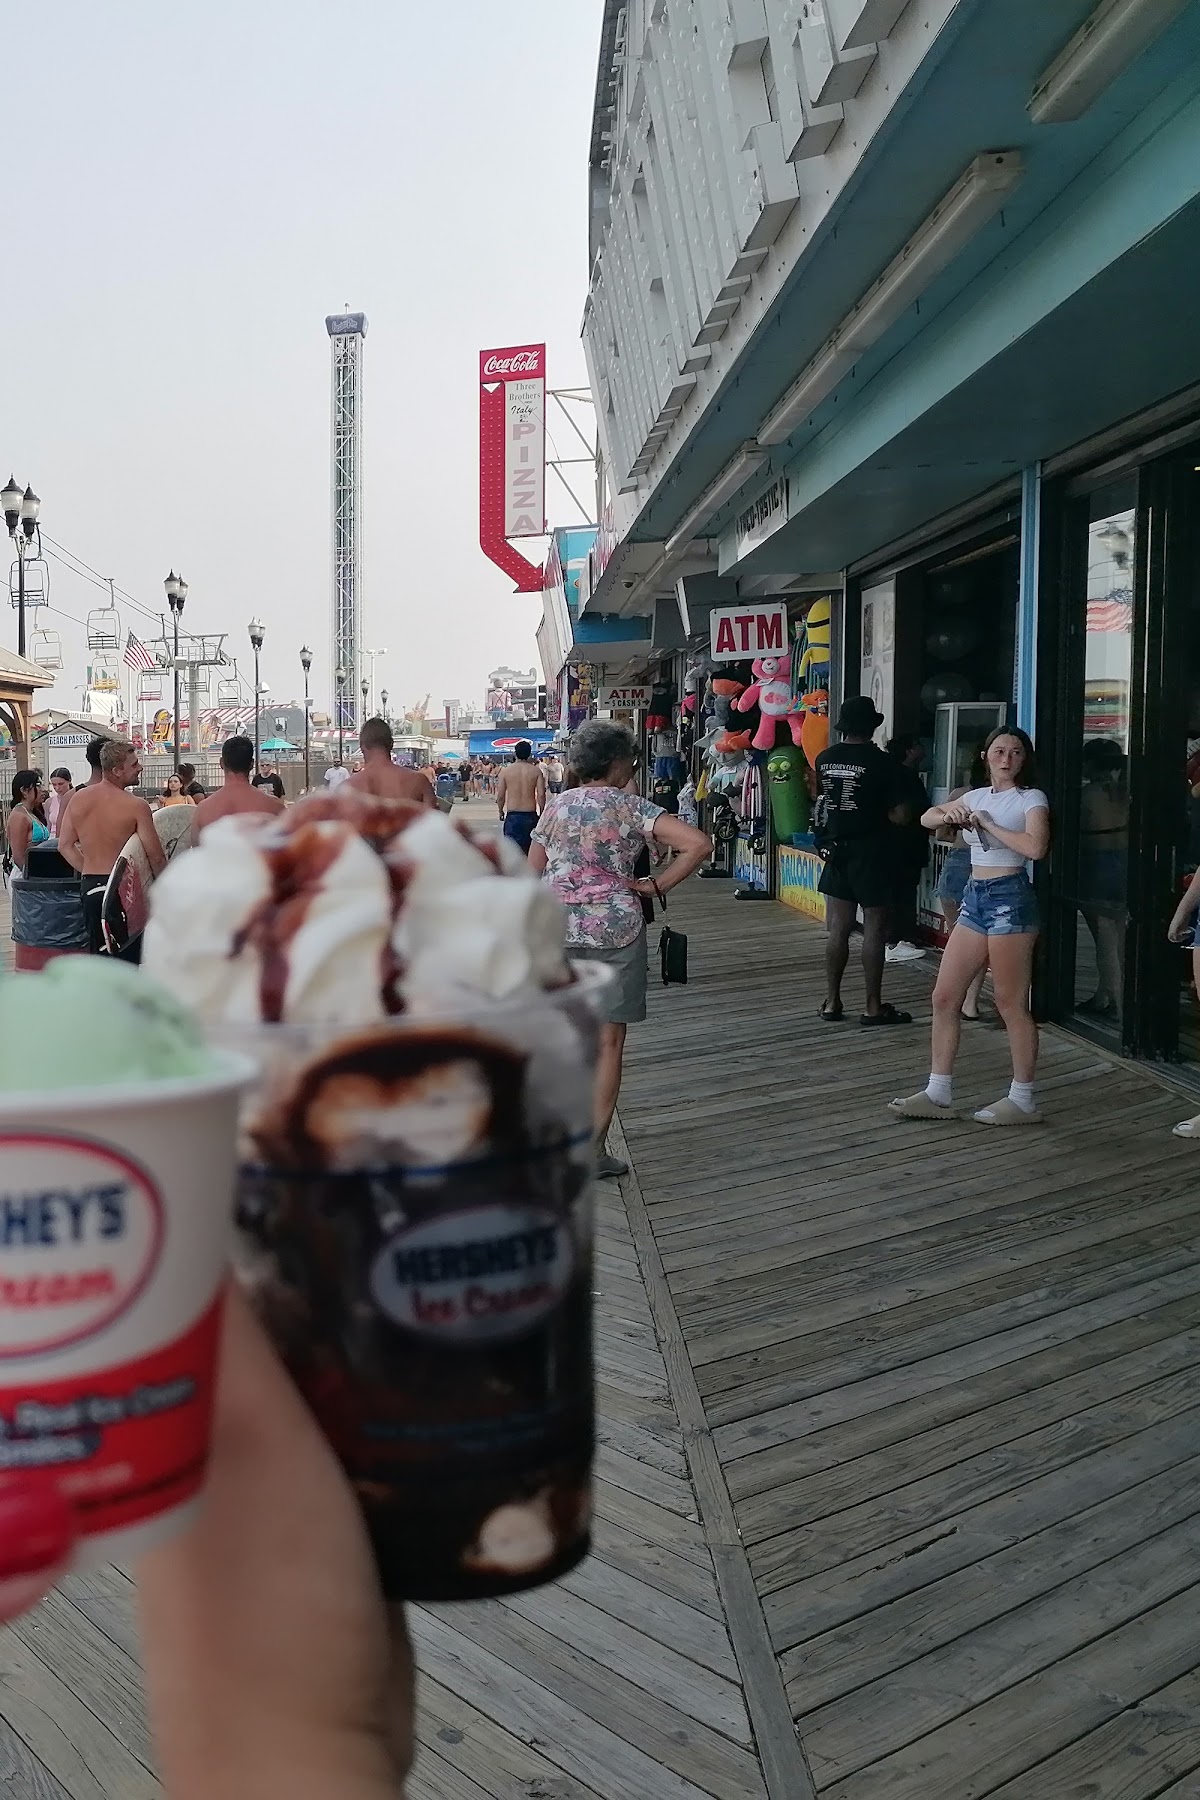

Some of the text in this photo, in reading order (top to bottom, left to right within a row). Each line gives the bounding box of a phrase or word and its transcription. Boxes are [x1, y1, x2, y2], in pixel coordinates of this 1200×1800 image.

[515, 382, 536, 391] Three
[509, 392, 541, 401] Brothers
[511, 404, 538, 416] Italy
[510, 422, 538, 533] PIZZA
[715, 612, 783, 654] ATM
[608, 688, 645, 699] ATM
[49, 734, 90, 745] BEACH PASSES
